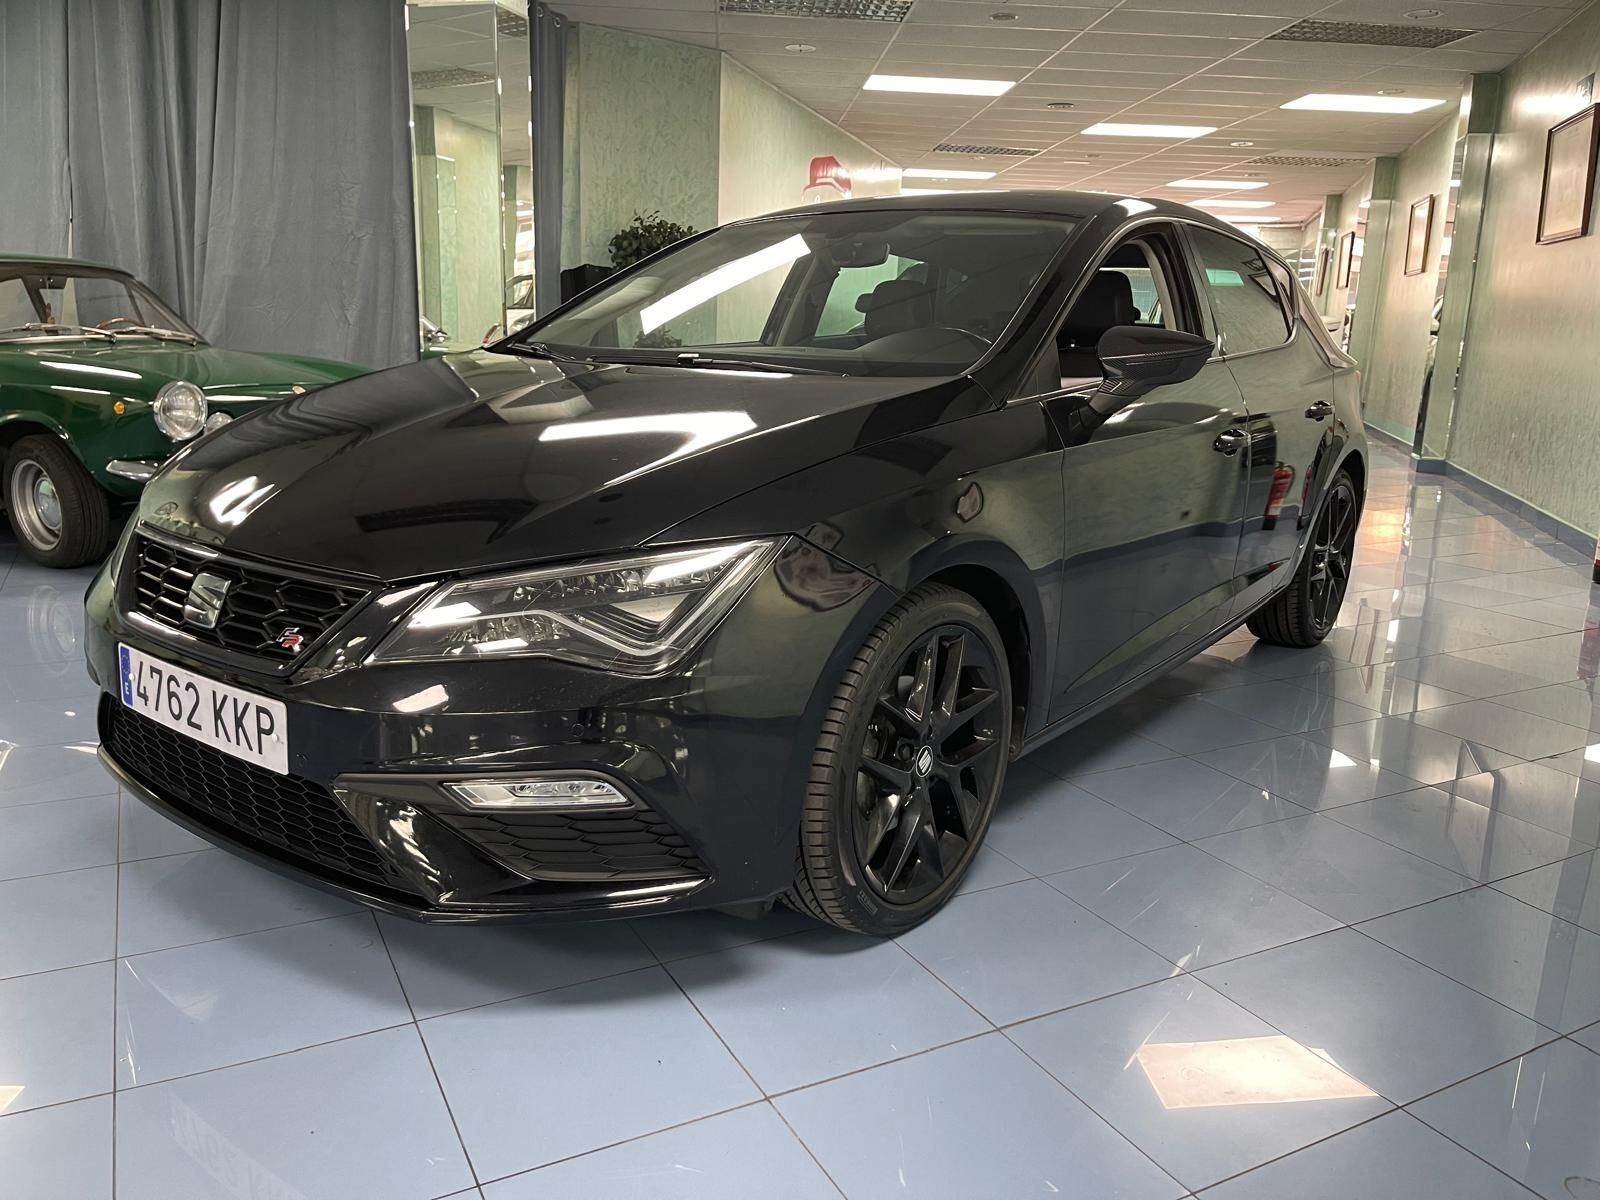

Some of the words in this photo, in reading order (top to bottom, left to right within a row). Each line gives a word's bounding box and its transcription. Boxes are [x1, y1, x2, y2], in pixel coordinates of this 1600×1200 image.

[124, 682, 130, 695] E
[136, 661, 202, 731] 4762
[212, 690, 275, 755] KKP
